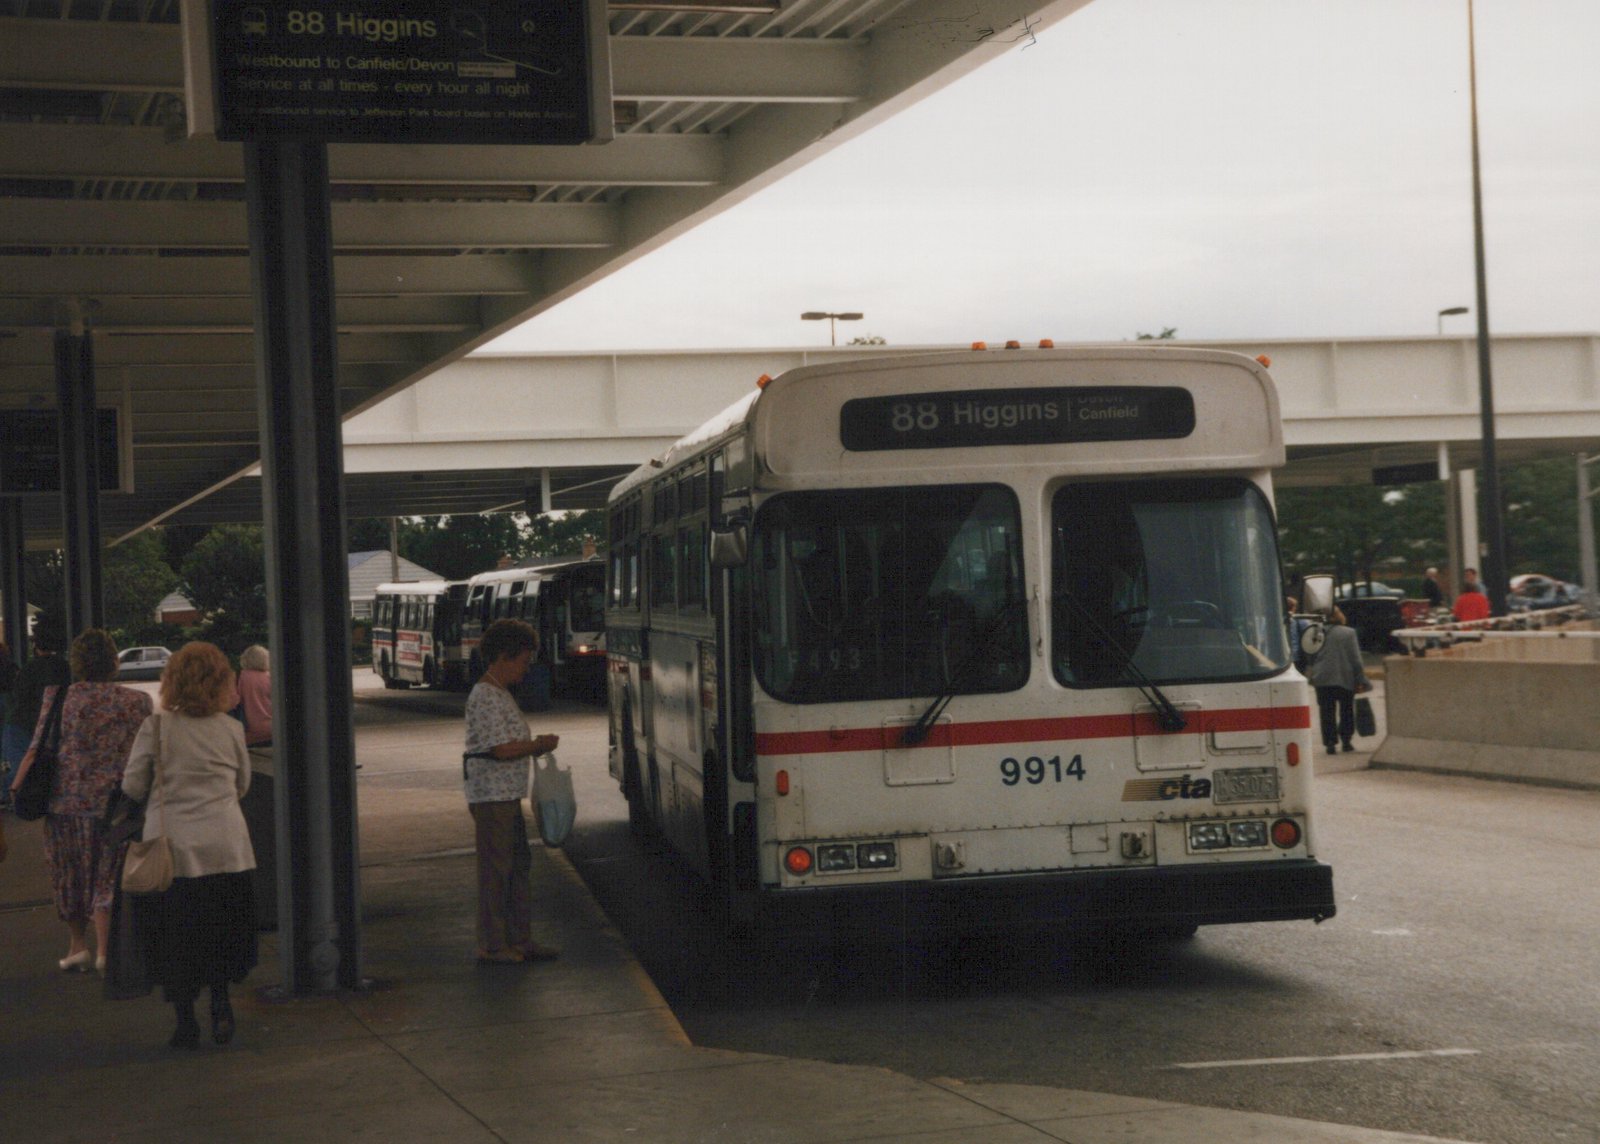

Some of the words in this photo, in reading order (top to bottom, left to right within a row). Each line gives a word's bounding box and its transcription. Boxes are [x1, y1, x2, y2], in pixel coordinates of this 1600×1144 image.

[287, 10, 325, 35] 88
[336, 11, 437, 42] Higgins
[237, 55, 321, 69] Westbound
[326, 57, 340, 69] to
[346, 56, 454, 71] Canfield/Devon
[237, 78, 292, 91] Service
[298, 79, 313, 91] at
[318, 79, 334, 92] all
[340, 79, 378, 93] times
[394, 83, 432, 98] every
[438, 82, 469, 95] hour
[475, 82, 491, 95] all
[496, 82, 530, 98] night
[408, 107, 430, 118] Park
[433, 108, 461, 118] board
[464, 108, 491, 118] buses
[508, 109, 541, 119] Harlem
[891, 401, 940, 432] 88
[953, 400, 1059, 429] Higgins
[1079, 405, 1139, 420] Canfield
[1000, 754, 1086, 786] 9914
[1159, 774, 1212, 800] cta
